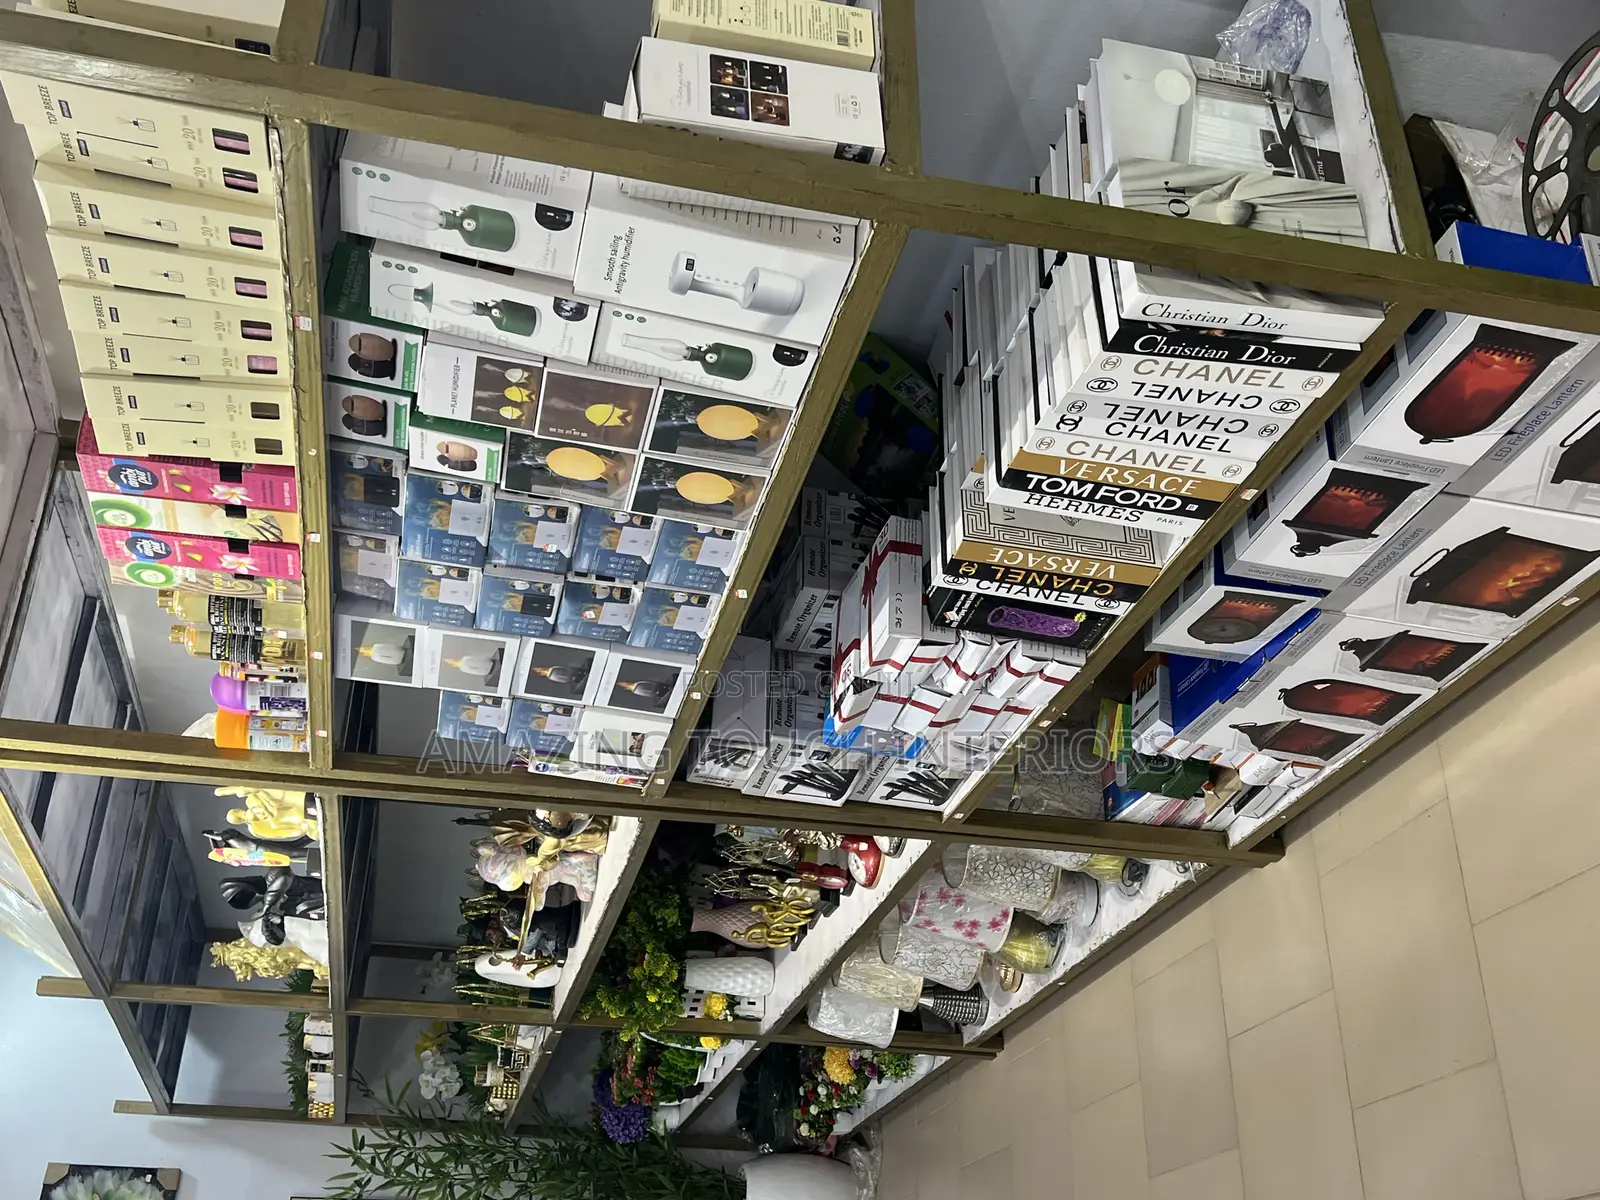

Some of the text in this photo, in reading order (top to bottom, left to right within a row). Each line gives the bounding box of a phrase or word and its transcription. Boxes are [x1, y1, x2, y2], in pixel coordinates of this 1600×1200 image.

[38, 84, 58, 125] TOP BREEZE
[67, 147, 76, 162] TOP
[69, 191, 86, 227] TOP BREEZE
[1164, 181, 1191, 218] or
[81, 245, 96, 280] TOP BREEZE
[604, 235, 623, 282] Smooth sailing
[614, 226, 636, 295] Antigravity humidifier
[92, 295, 107, 330] TOP BREEZE
[1141, 302, 1288, 331] Christian Dior
[104, 337, 118, 371] TOP BREEZE
[1133, 334, 1230, 361] Christian
[1237, 345, 1296, 366] Dior
[1133, 359, 1286, 389] CHANEL
[112, 385, 122, 403] BREEZE
[1130, 381, 1263, 411] CHANEL
[1102, 402, 1250, 435] CHANEL
[1489, 378, 1587, 462] LED Fireplace Lantern
[121, 423, 134, 453] TOP BREEZE
[1105, 421, 1233, 454] CHANEL
[1066, 440, 1207, 475] CHANEL
[1025, 474, 1182, 512] TOM FORD
[1058, 459, 1202, 495] VERSACE
[804, 499, 812, 527] Remote
[814, 491, 824, 528] Organizer
[1023, 492, 1145, 524] HERMES
[1156, 517, 1184, 526] PARIS
[808, 549, 816, 577] Remote
[818, 541, 828, 578] Organizer
[985, 547, 1116, 580] VERSACE
[1352, 526, 1426, 588] LED Fireplace Lantern
[976, 579, 1086, 606] CHANEL
[990, 566, 1115, 596] CHANEL
[785, 594, 818, 644] Remote Organizer
[774, 699, 783, 727] Remote
[752, 742, 784, 790] Remote Organizer
[1252, 765, 1269, 779] AVC
[857, 774, 873, 796] Remote
